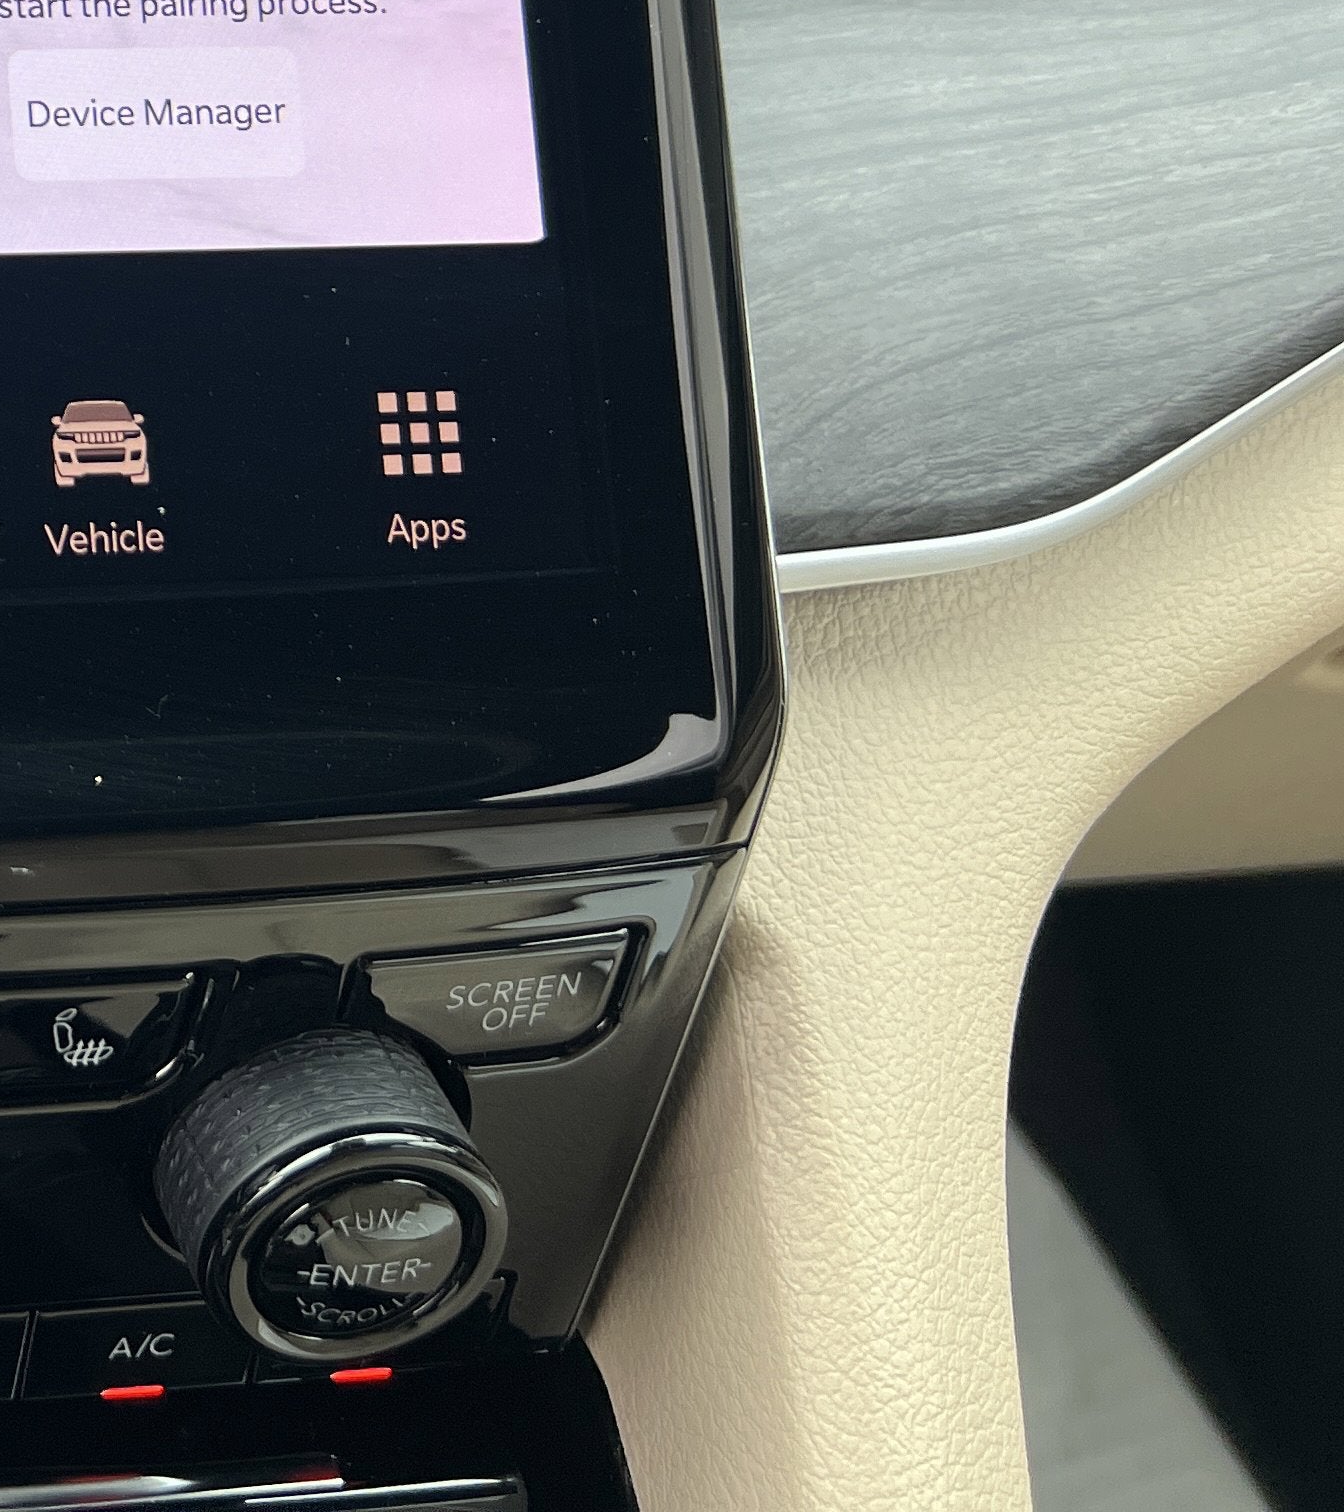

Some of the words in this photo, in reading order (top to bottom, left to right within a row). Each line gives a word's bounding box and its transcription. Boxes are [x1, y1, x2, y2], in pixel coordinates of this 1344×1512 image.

[28, 98, 135, 129] Device
[144, 97, 286, 132] Manager
[43, 518, 167, 557] Vehicle
[386, 510, 468, 550] Apps
[445, 972, 582, 1011] SCREEN
[480, 1002, 548, 1032] OFF
[332, 1208, 420, 1237] TUNE
[108, 1333, 175, 1361] A/C
